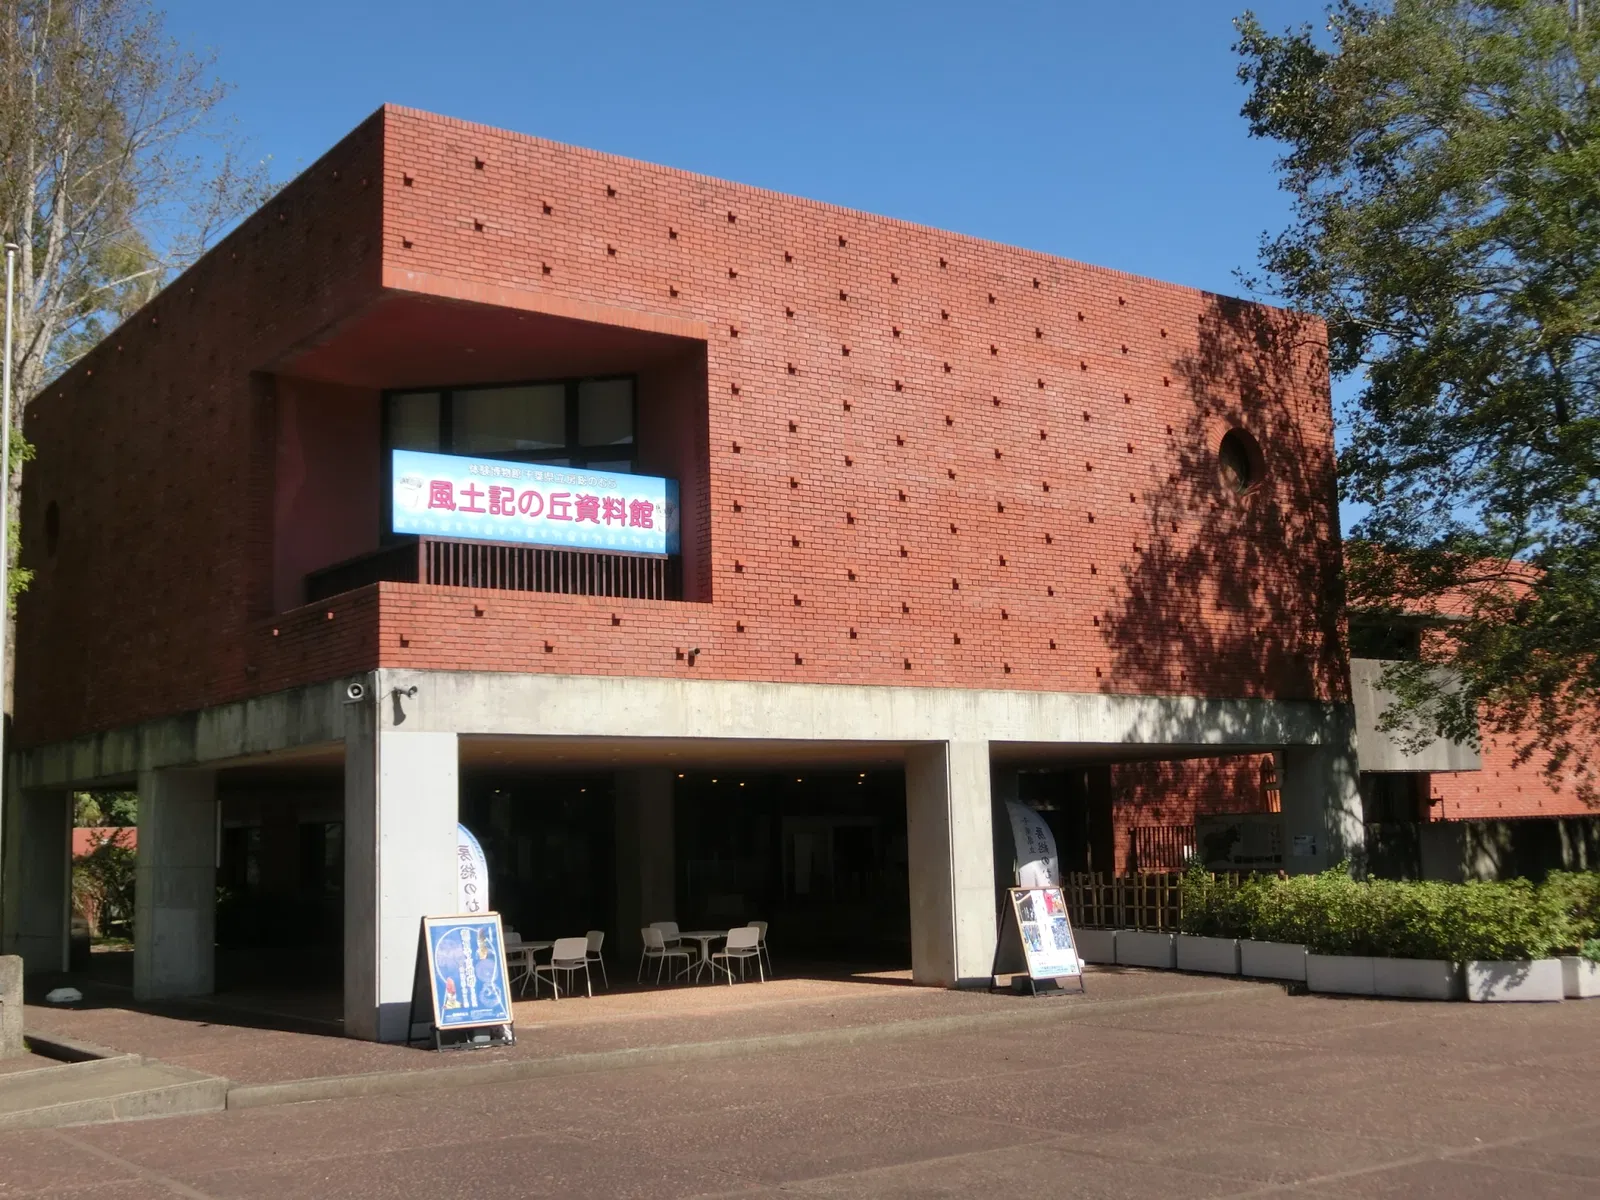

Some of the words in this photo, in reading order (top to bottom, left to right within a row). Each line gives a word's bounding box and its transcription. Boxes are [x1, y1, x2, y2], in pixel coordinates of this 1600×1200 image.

[427, 480, 655, 529] 風土記の丘資料館
